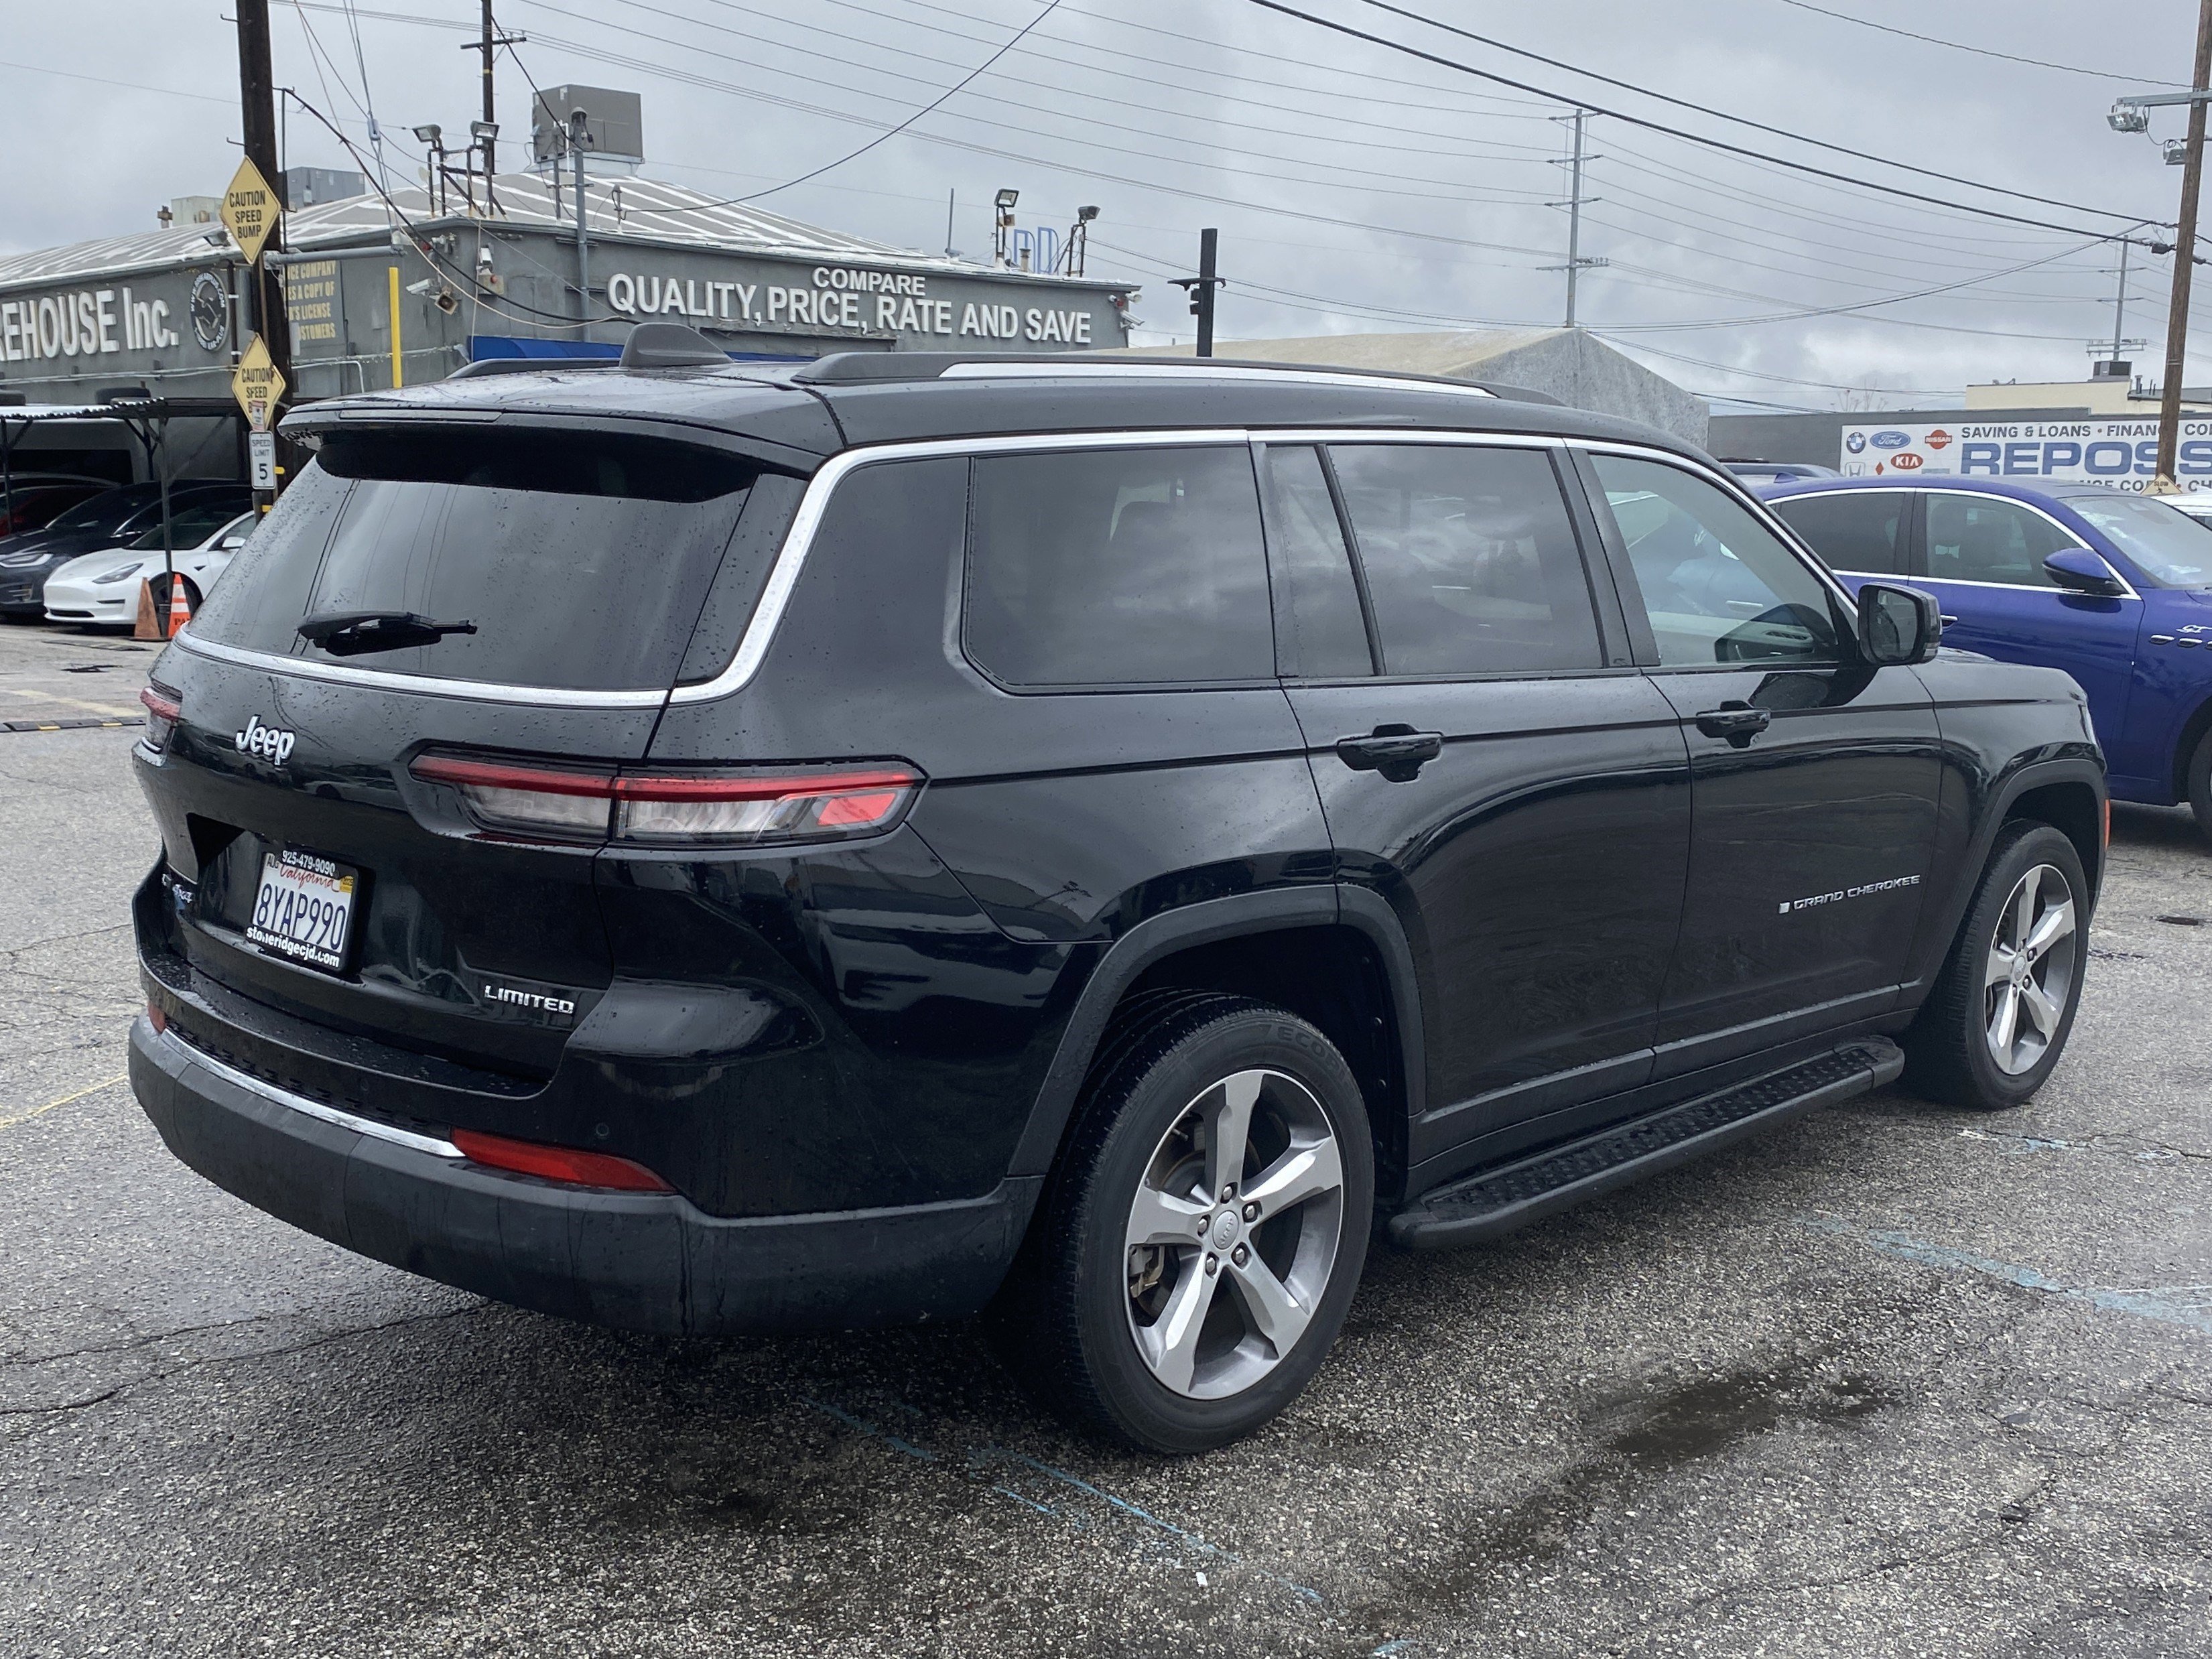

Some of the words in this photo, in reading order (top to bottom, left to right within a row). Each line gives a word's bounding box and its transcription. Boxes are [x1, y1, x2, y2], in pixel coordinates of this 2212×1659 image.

[229, 190, 265, 208] CAUTION
[235, 210, 262, 224] SPEED
[237, 224, 261, 239] BUMP
[301, 260, 336, 279] COMPANY
[298, 285, 303, 300] A
[304, 282, 323, 299] COPY
[325, 281, 334, 297] OF
[813, 267, 926, 296] COMPARE
[302, 302, 331, 320] LICENSE
[607, 273, 762, 326] QUALITY,
[767, 286, 868, 334] PRICE,
[876, 295, 952, 334] RATE
[959, 303, 1019, 338] AND
[1025, 308, 1092, 344] SAVE
[122, 287, 180, 350] Inc.
[299, 322, 336, 340] STOMERS
[242, 368, 272, 383] CAUTION
[246, 387, 267, 399] SPEED
[248, 401, 267, 413] BP
[1961, 426, 2018, 438] SAVING
[2024, 426, 2034, 437] &
[2038, 425, 2091, 437] LOANS
[2107, 424, 2157, 436] FINAN
[1878, 435, 1902, 446] Ford
[254, 449, 269, 457] LIMIT
[1895, 456, 1919, 466] KIA
[259, 463, 268, 480] 5
[236, 715, 295, 765] Jeep
[279, 863, 340, 892] California
[1793, 891, 1844, 910] GRAND
[1847, 874, 1921, 898] CHEROKEE
[257, 883, 346, 950] 8YAP990
[246, 926, 340, 968] stoneridgecjd.com
[484, 985, 575, 1014] LIMITED
